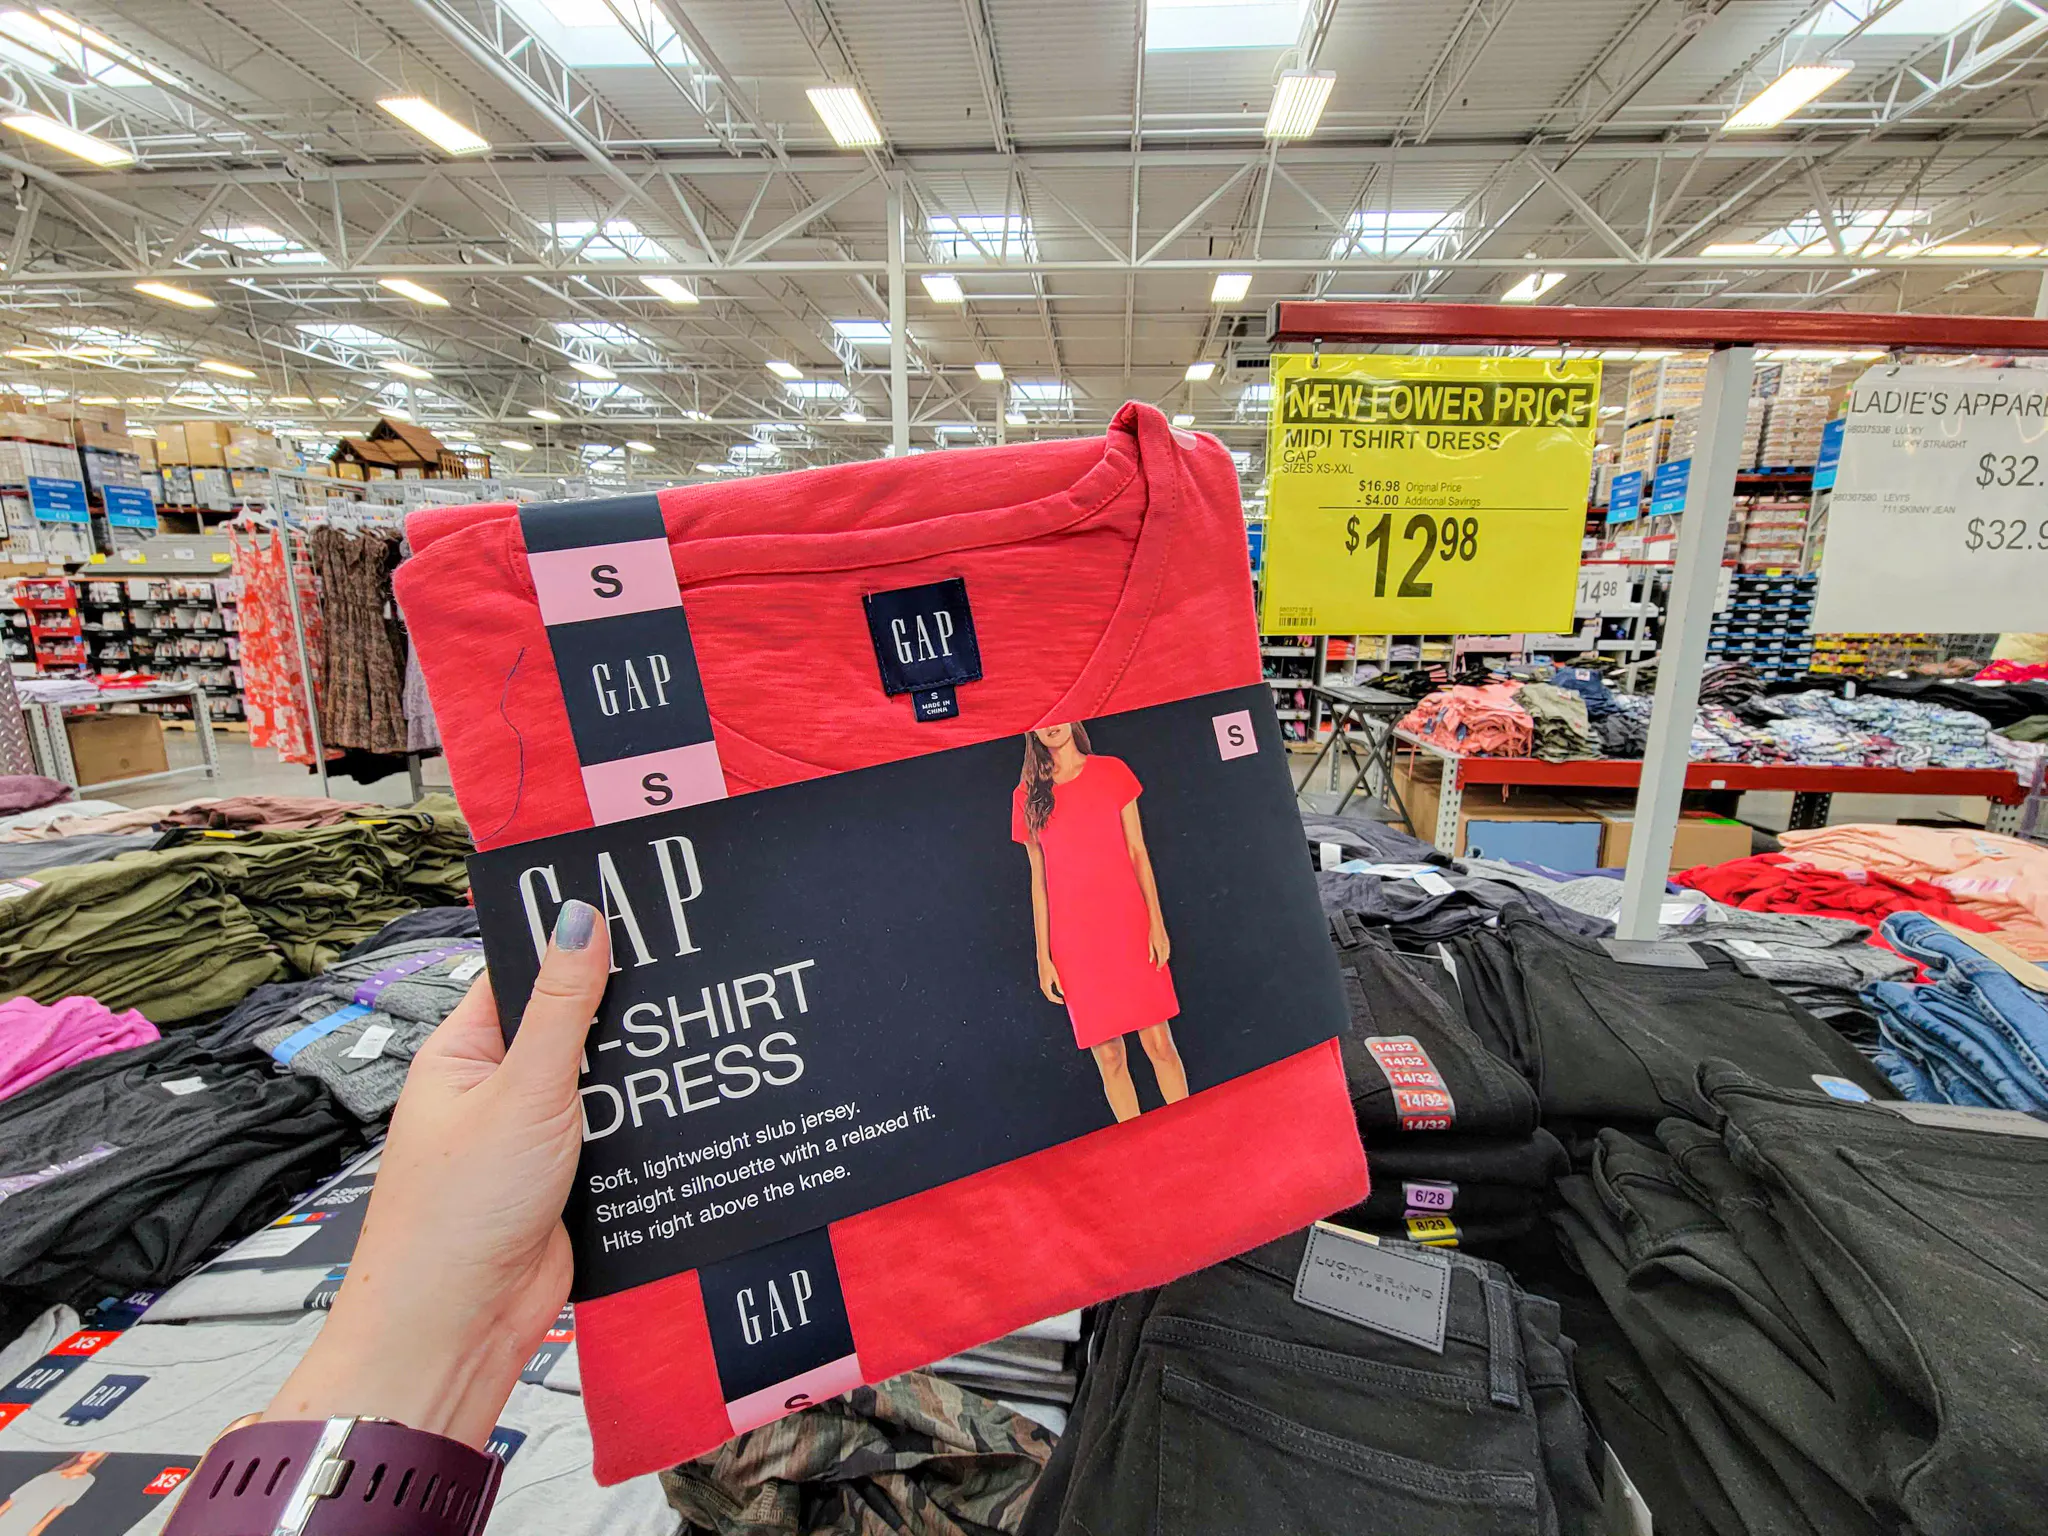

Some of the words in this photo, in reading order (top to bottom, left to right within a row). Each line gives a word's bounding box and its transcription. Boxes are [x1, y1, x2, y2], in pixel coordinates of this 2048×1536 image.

[1288, 383, 1363, 418] NEW
[1371, 384, 1485, 421] LOWER
[1492, 387, 1588, 423] PRICE
[1851, 389, 1949, 416] LADIE'S
[1285, 428, 1332, 449] MIDI
[1340, 429, 1420, 450] TSHIRT
[1426, 430, 1501, 451] DRESS
[1922, 439, 1968, 449] STRAIGHT
[1283, 449, 1318, 463] GAP
[1282, 463, 1314, 474] SIZES
[1315, 463, 1354, 475] XS-XXL
[1358, 480, 1401, 492] $16.98
[1405, 482, 1438, 494] Original
[1440, 482, 1463, 493] Price
[1365, 494, 1399, 507] $4.00
[1404, 496, 1447, 507] Additional
[1447, 496, 1481, 509] Savings
[1932, 505, 1957, 515] JEAN
[590, 564, 624, 599] S
[890, 610, 954, 664] GAP
[591, 653, 672, 717] GAP
[930, 691, 939, 700] S
[921, 701, 942, 710] MADE
[942, 699, 951, 707] IN
[926, 707, 948, 716] CHINA
[1227, 724, 1245, 747] S
[641, 772, 674, 806] S
[1375, 1043, 1413, 1053] 14/32
[1384, 1057, 1425, 1066] 14/32
[577, 1030, 805, 1142] DRESS
[1394, 1073, 1435, 1083] 14/32
[1402, 1093, 1445, 1108] 14/32
[1407, 1119, 1448, 1131] 14/32
[589, 1167, 639, 1194] Soft,
[642, 1131, 752, 1180] lightweight
[755, 1118, 796, 1145] slub
[800, 1101, 861, 1135] jersey.
[596, 1185, 677, 1223] Straight
[680, 1157, 776, 1198] silhouette
[779, 1141, 820, 1167] with
[824, 1138, 839, 1153] a
[841, 1110, 910, 1148] relaxed
[911, 1104, 937, 1124] fit.
[1415, 1189, 1445, 1206] 6/28
[602, 1229, 644, 1254] Hits
[648, 1211, 695, 1240] right
[698, 1193, 760, 1225] above
[762, 1181, 796, 1203] the
[798, 1164, 851, 1192] knee.
[1416, 1219, 1446, 1232] 8/29
[736, 1268, 813, 1346] GAP
[68, 1336, 101, 1350] XS
[16, 1367, 65, 1389] GAP
[81, 1384, 127, 1407] GAP
[151, 1473, 183, 1489] XS
